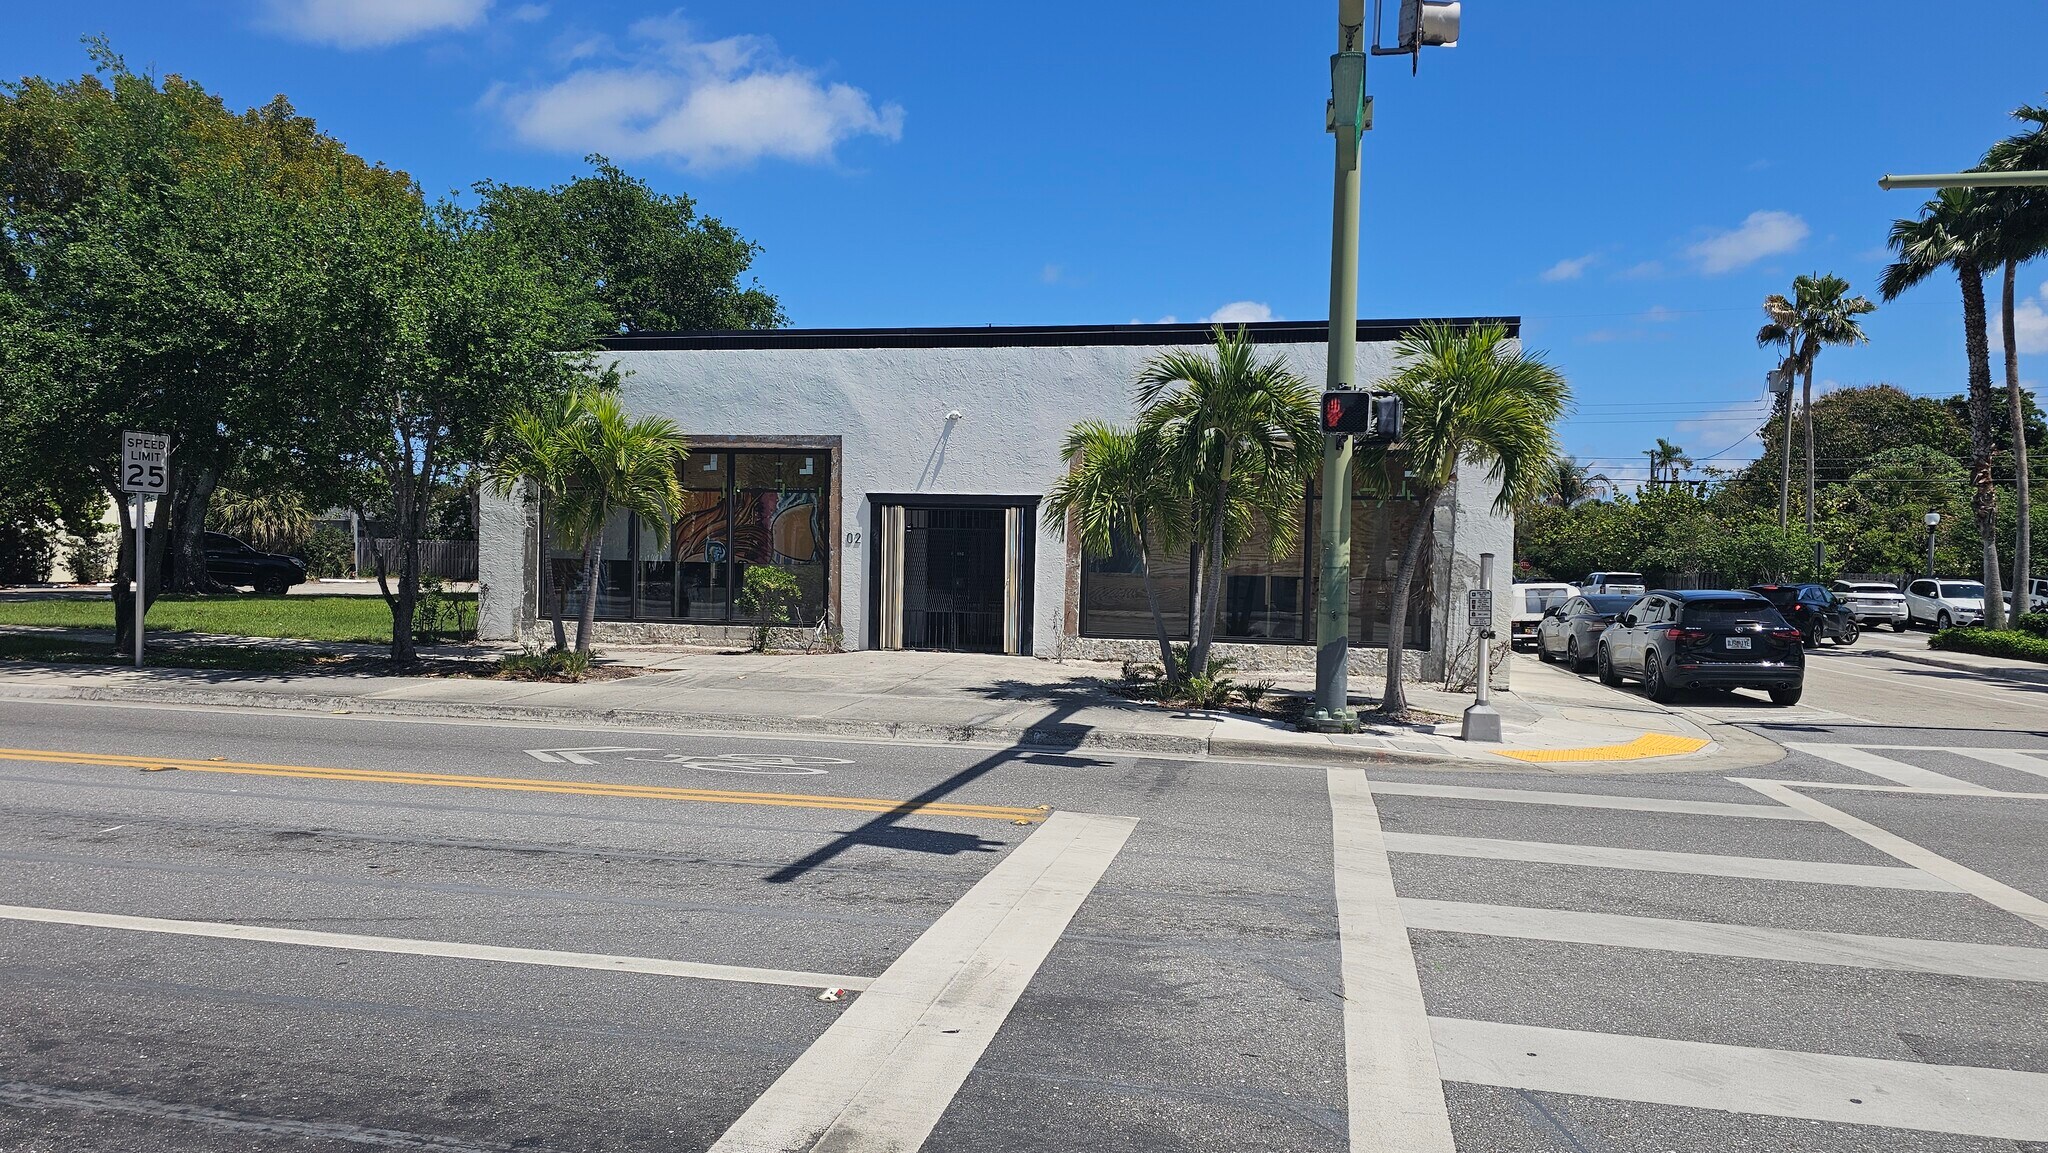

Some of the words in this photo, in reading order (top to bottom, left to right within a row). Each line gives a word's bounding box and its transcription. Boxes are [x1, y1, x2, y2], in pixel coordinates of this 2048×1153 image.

[127, 438, 166, 450] SPEED
[131, 451, 161, 462] LIMIT
[127, 464, 165, 488] 25
[847, 532, 861, 544] 02
